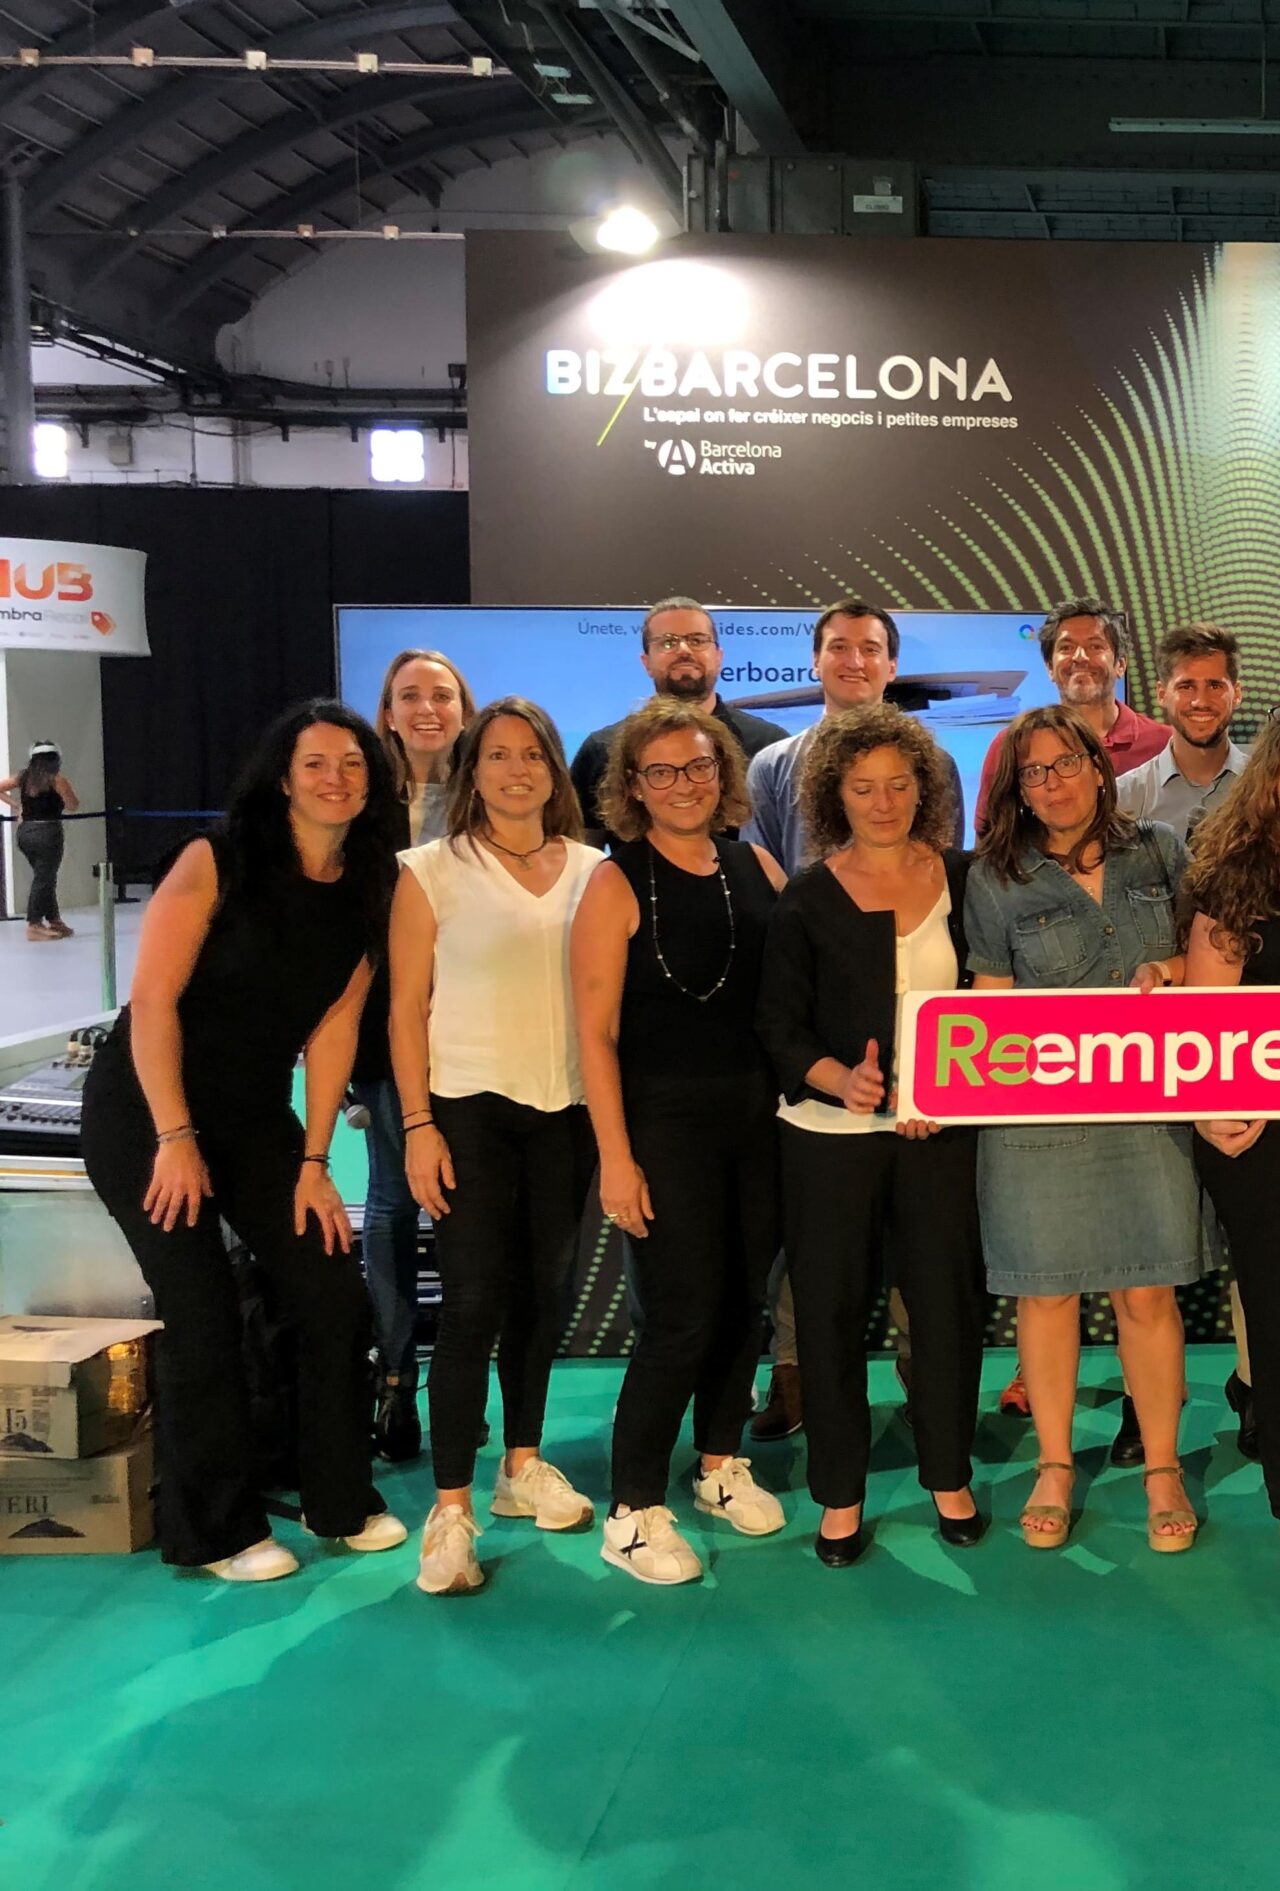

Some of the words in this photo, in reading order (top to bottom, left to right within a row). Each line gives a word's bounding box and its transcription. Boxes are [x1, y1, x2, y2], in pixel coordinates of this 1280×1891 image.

[703, 410, 725, 424] on
[811, 411, 873, 428] negocis
[877, 411, 882, 425] i
[886, 412, 938, 428] petites
[942, 416, 1018, 431] empreses
[700, 440, 782, 458] Barcelona
[700, 458, 755, 475] Activa
[578, 618, 627, 635] Únete,
